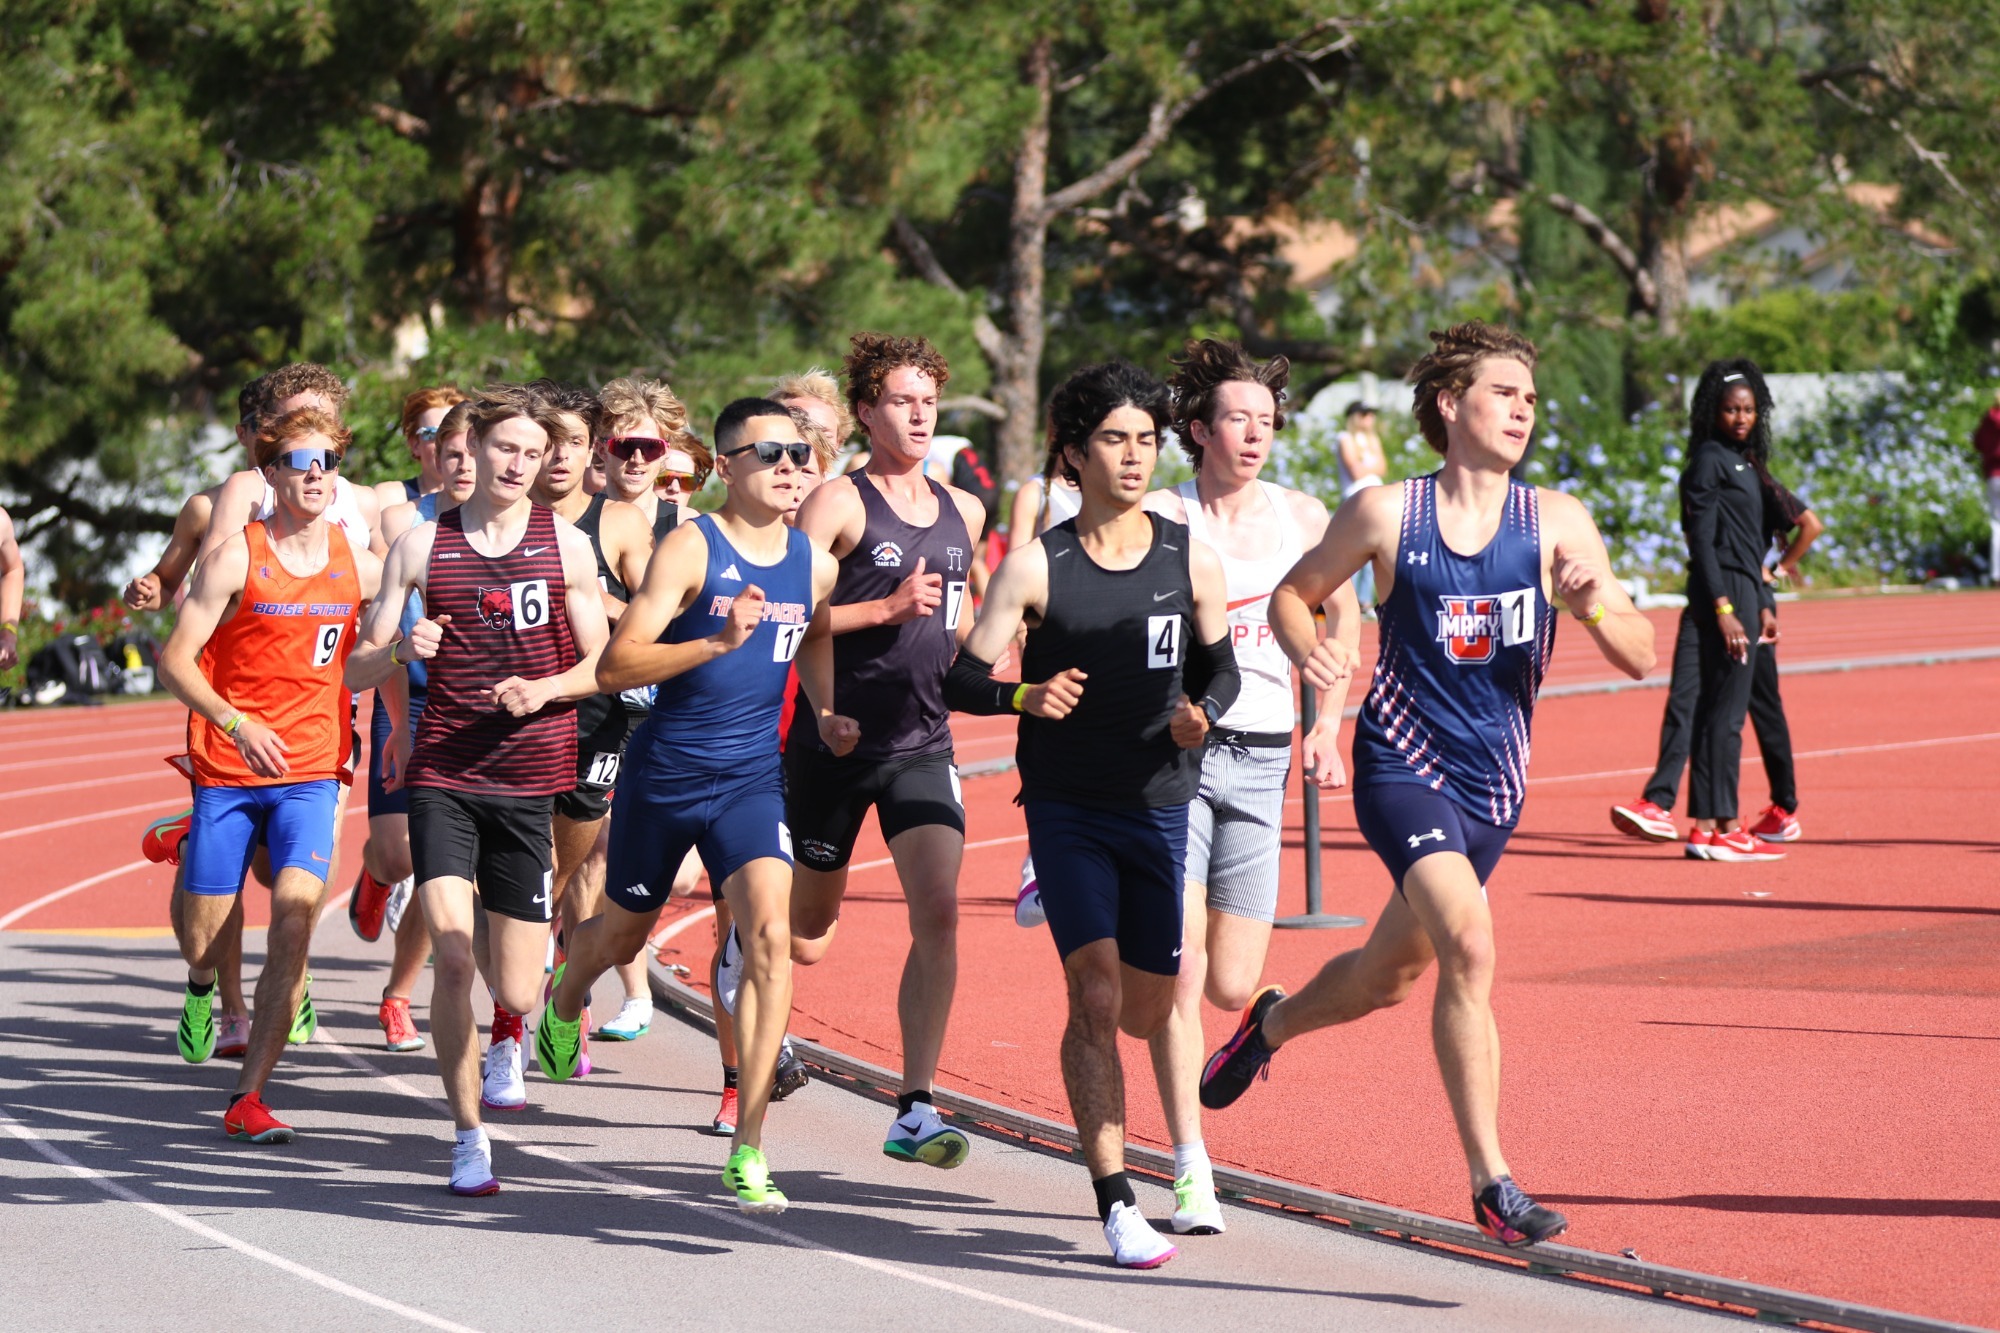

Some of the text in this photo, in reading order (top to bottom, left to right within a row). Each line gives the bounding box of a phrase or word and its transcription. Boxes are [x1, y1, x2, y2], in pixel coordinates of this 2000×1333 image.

[253, 602, 353, 616] BOISE STATE
[520, 583, 542, 626] 6
[762, 601, 806, 625] PACIFIC
[952, 585, 964, 627] 7
[1511, 594, 1524, 639] 1
[1154, 619, 1175, 664] 4
[1441, 613, 1500, 638] MARY
[320, 627, 339, 665] 9
[596, 754, 619, 783] 12
